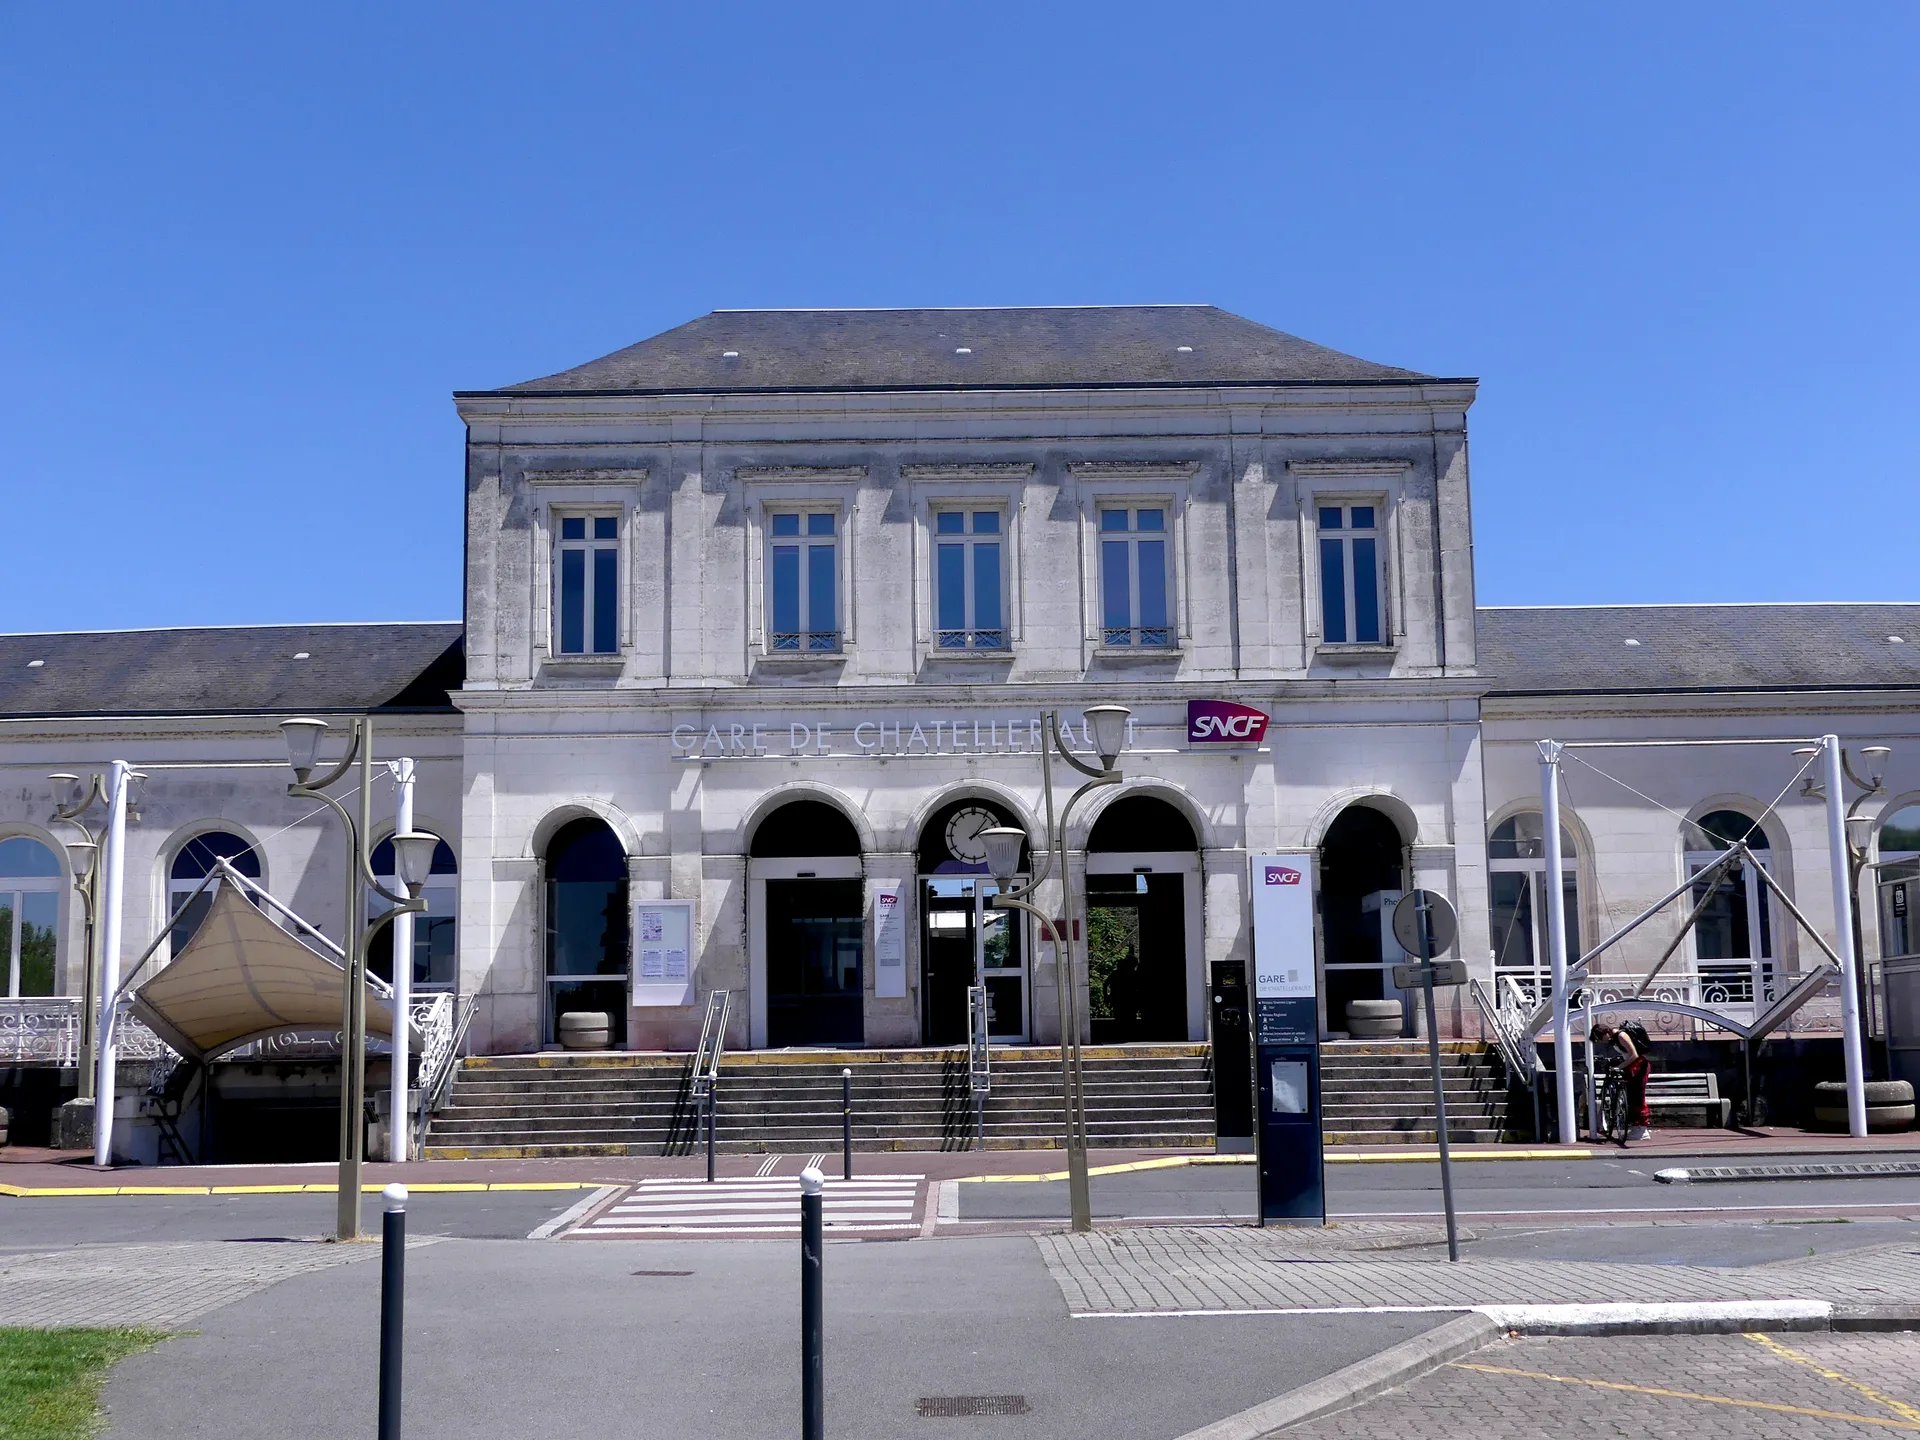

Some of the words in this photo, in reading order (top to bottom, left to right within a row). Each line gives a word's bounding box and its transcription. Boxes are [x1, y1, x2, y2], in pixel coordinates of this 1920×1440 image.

[671, 723, 768, 750] GARE
[790, 722, 832, 749] DE
[853, 718, 1139, 748] CHATELLERAUT
[1192, 715, 1265, 738] SNCF
[1266, 873, 1300, 883] SNCF
[1258, 975, 1286, 984] GARE
